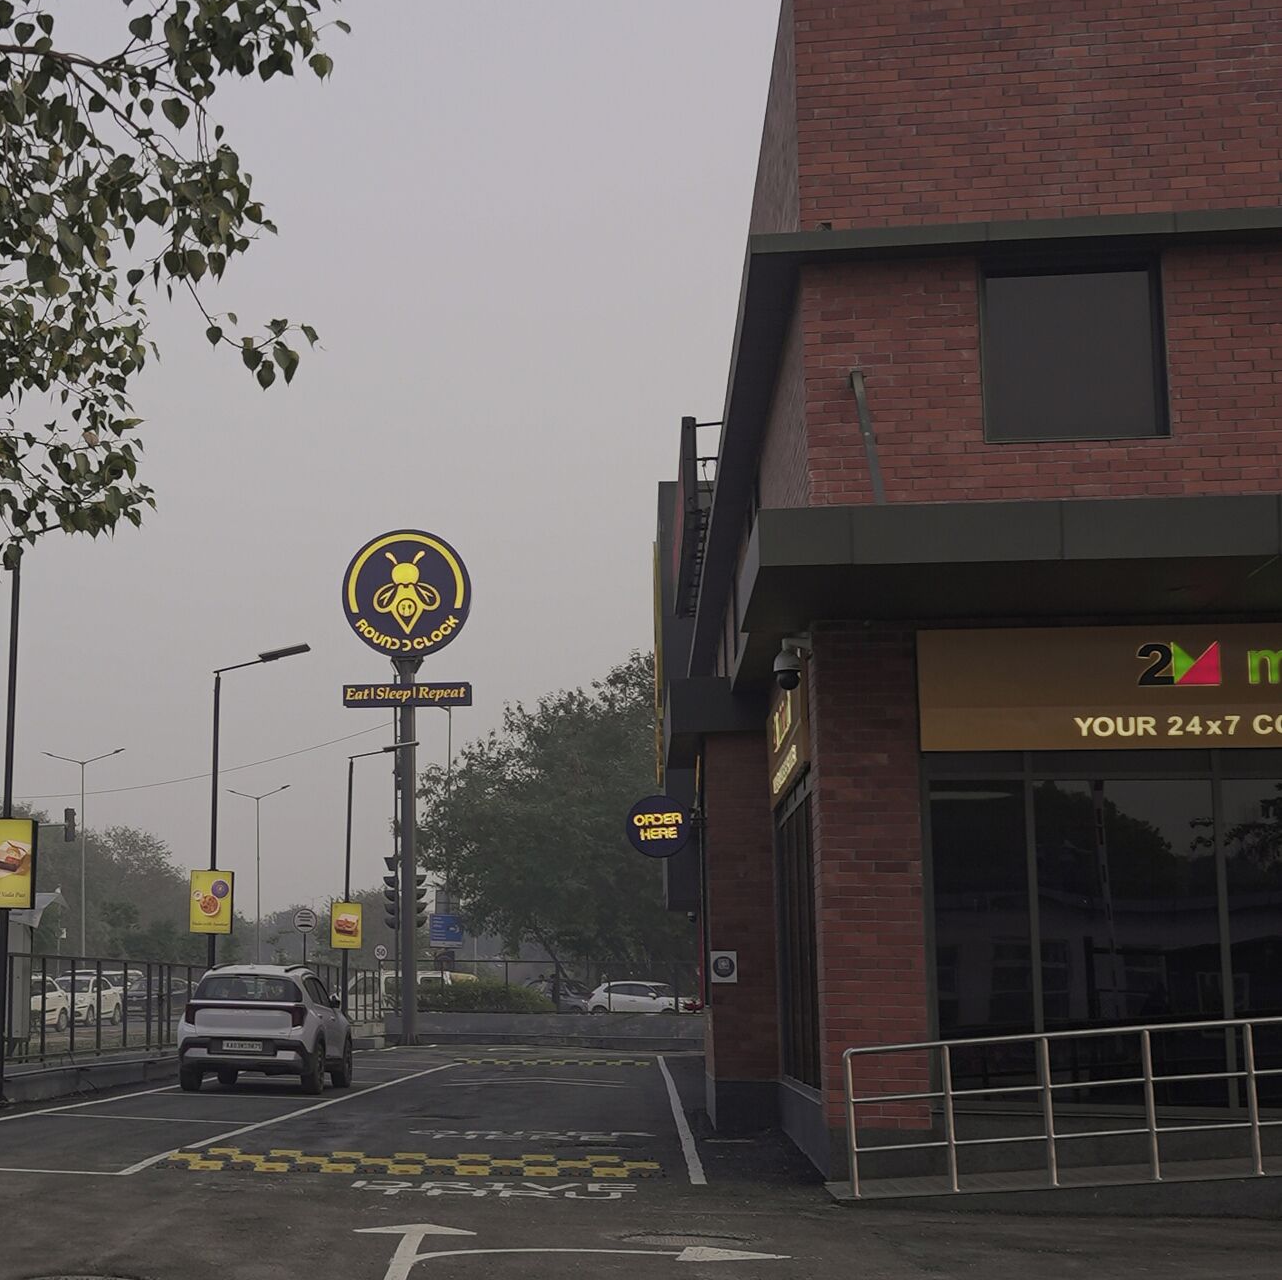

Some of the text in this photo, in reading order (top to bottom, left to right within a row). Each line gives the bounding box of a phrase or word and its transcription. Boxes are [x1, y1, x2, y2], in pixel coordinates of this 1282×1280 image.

[413, 614, 460, 650] CLOCK
[376, 687, 412, 703] Sleep
[418, 686, 466, 702] Repeat
[1073, 716, 1158, 737] YOUR
[1167, 715, 1241, 736] 24x7
[632, 812, 683, 827] ORDER
[639, 826, 678, 841] HERE
[351, 1180, 637, 1193] DRIVE
